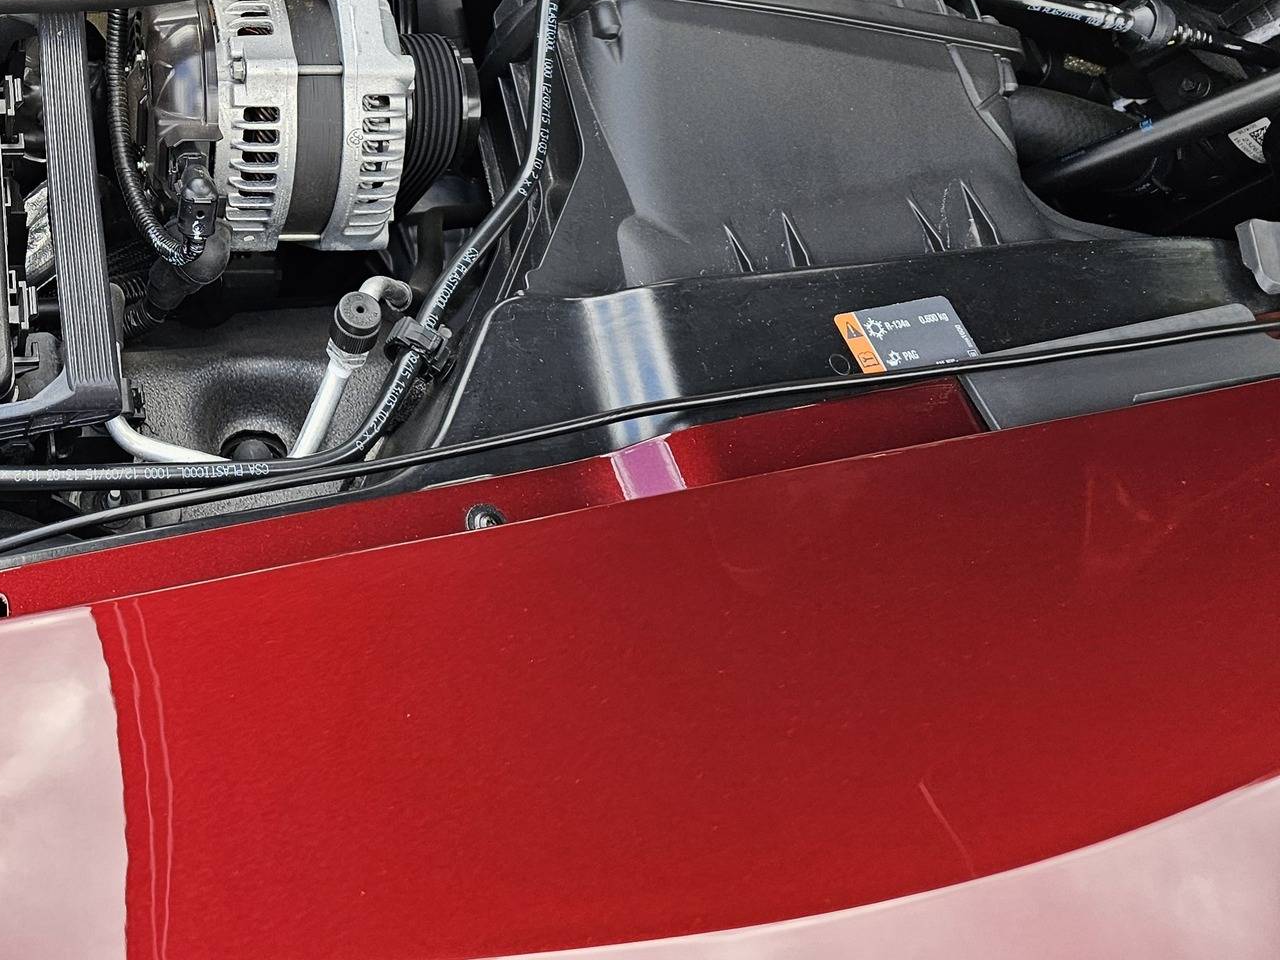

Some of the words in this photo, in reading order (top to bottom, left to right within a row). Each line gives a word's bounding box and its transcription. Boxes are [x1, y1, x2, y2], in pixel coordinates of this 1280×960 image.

[543, 58, 553, 79] 1000
[885, 318, 911, 332] R-134a
[938, 312, 949, 322] kg
[902, 350, 920, 362] PAG
[144, 467, 172, 479] 1000
[177, 464, 243, 479] PLASTICOOL
[248, 463, 269, 476] CSA
